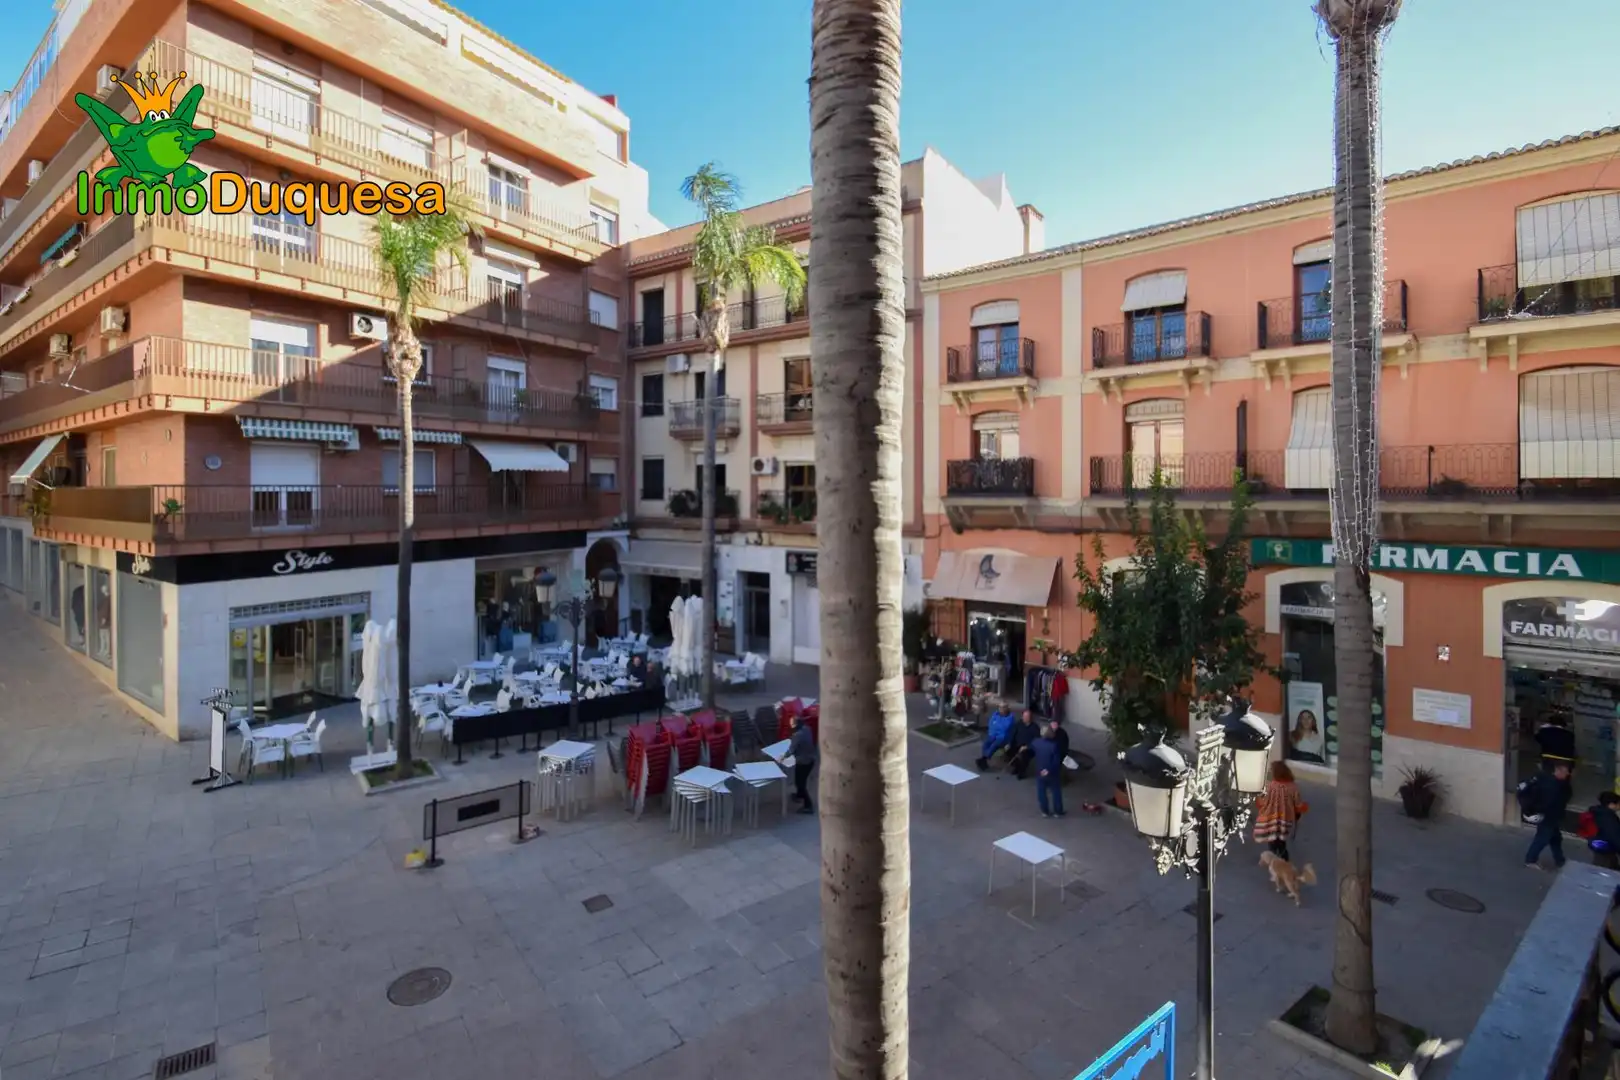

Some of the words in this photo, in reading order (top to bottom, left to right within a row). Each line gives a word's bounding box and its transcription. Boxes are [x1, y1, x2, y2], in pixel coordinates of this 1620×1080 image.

[273, 550, 334, 574] Style
[1322, 544, 1584, 578] FRMACIA
[1511, 621, 1620, 643] FARMACI
